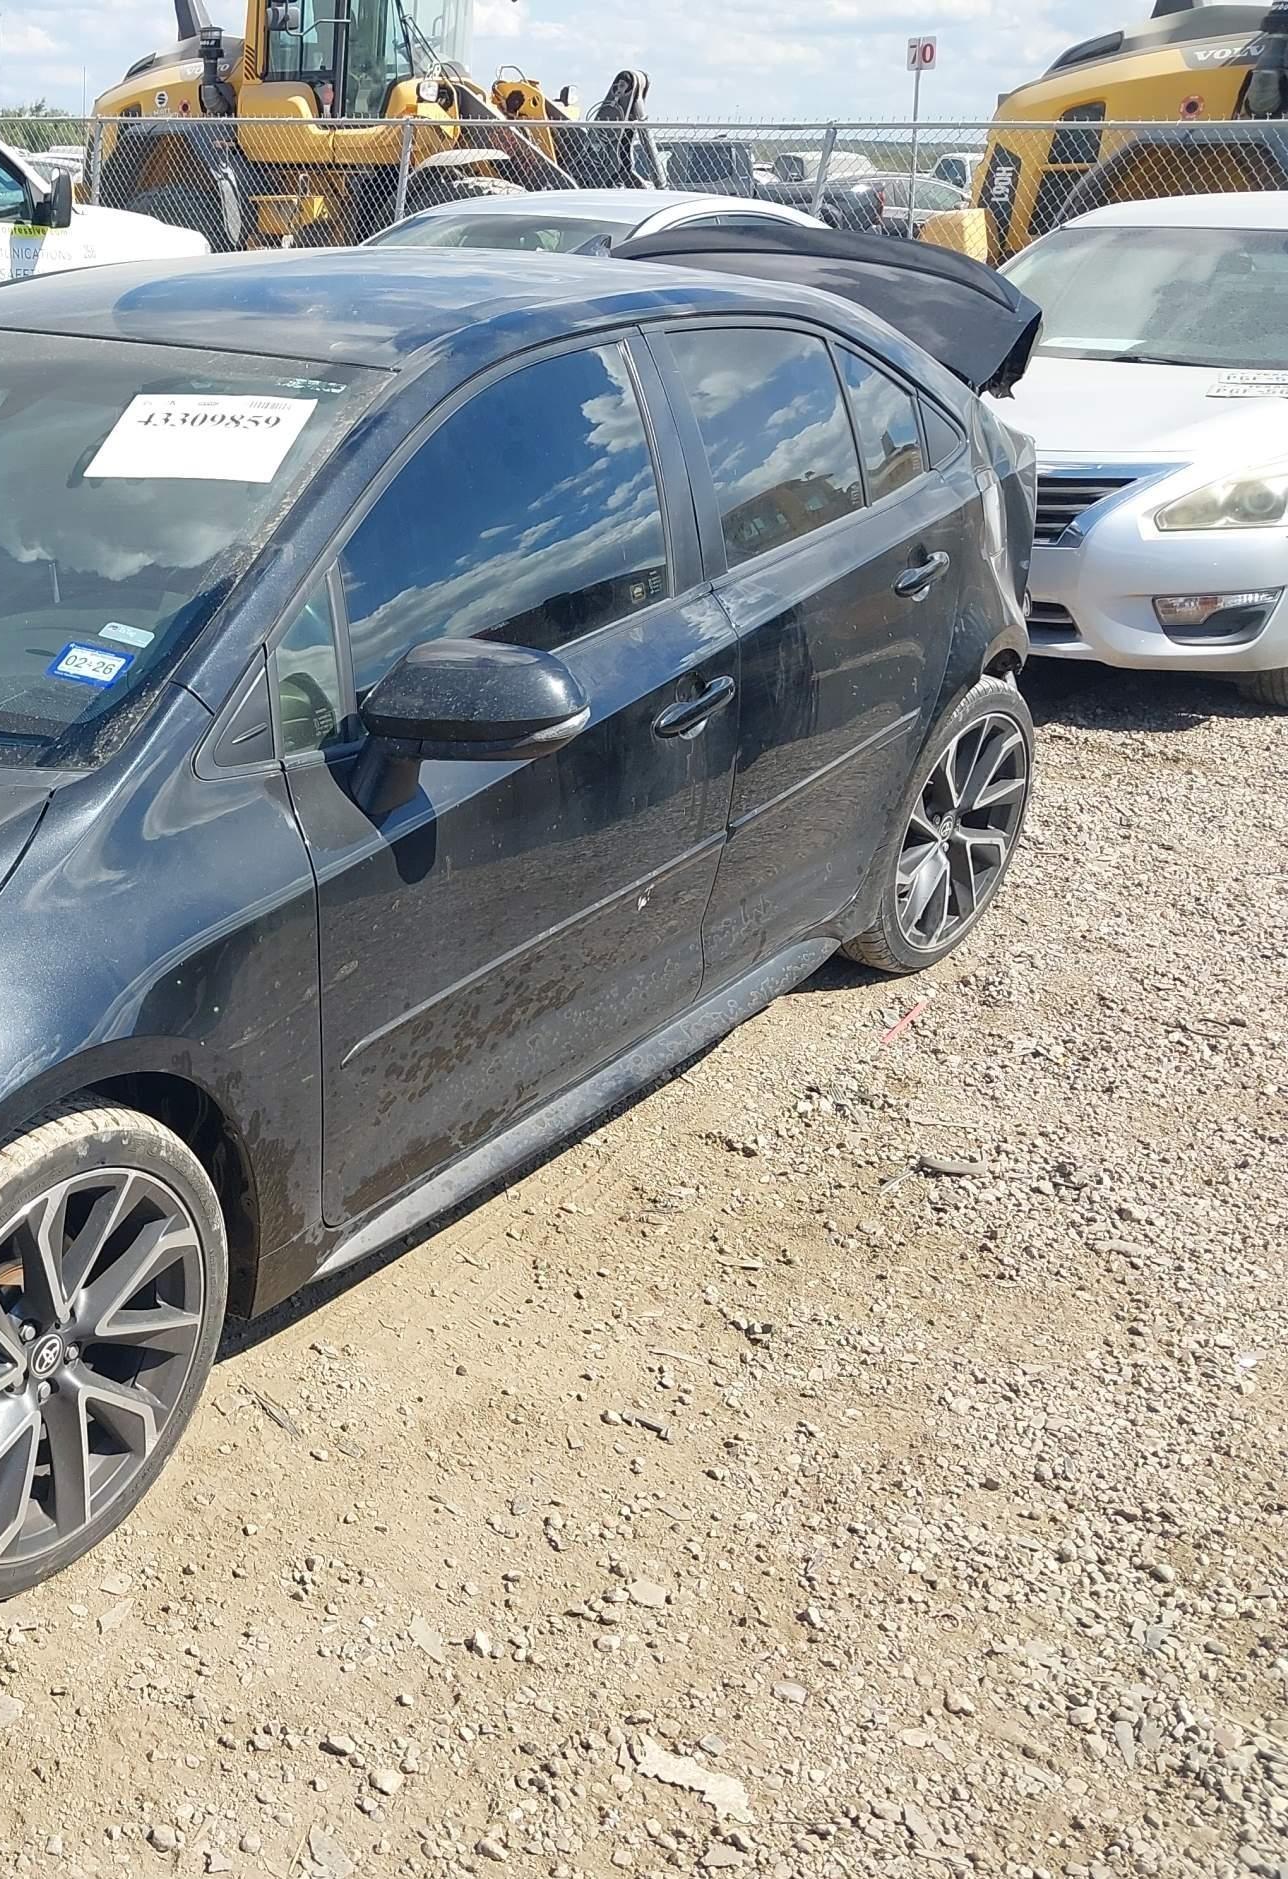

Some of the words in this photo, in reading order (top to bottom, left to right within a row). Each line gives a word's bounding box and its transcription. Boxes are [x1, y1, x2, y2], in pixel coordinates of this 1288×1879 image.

[909, 43, 935, 65] 70
[1192, 44, 1266, 62] VOLV
[136, 411, 281, 429] 43309859
